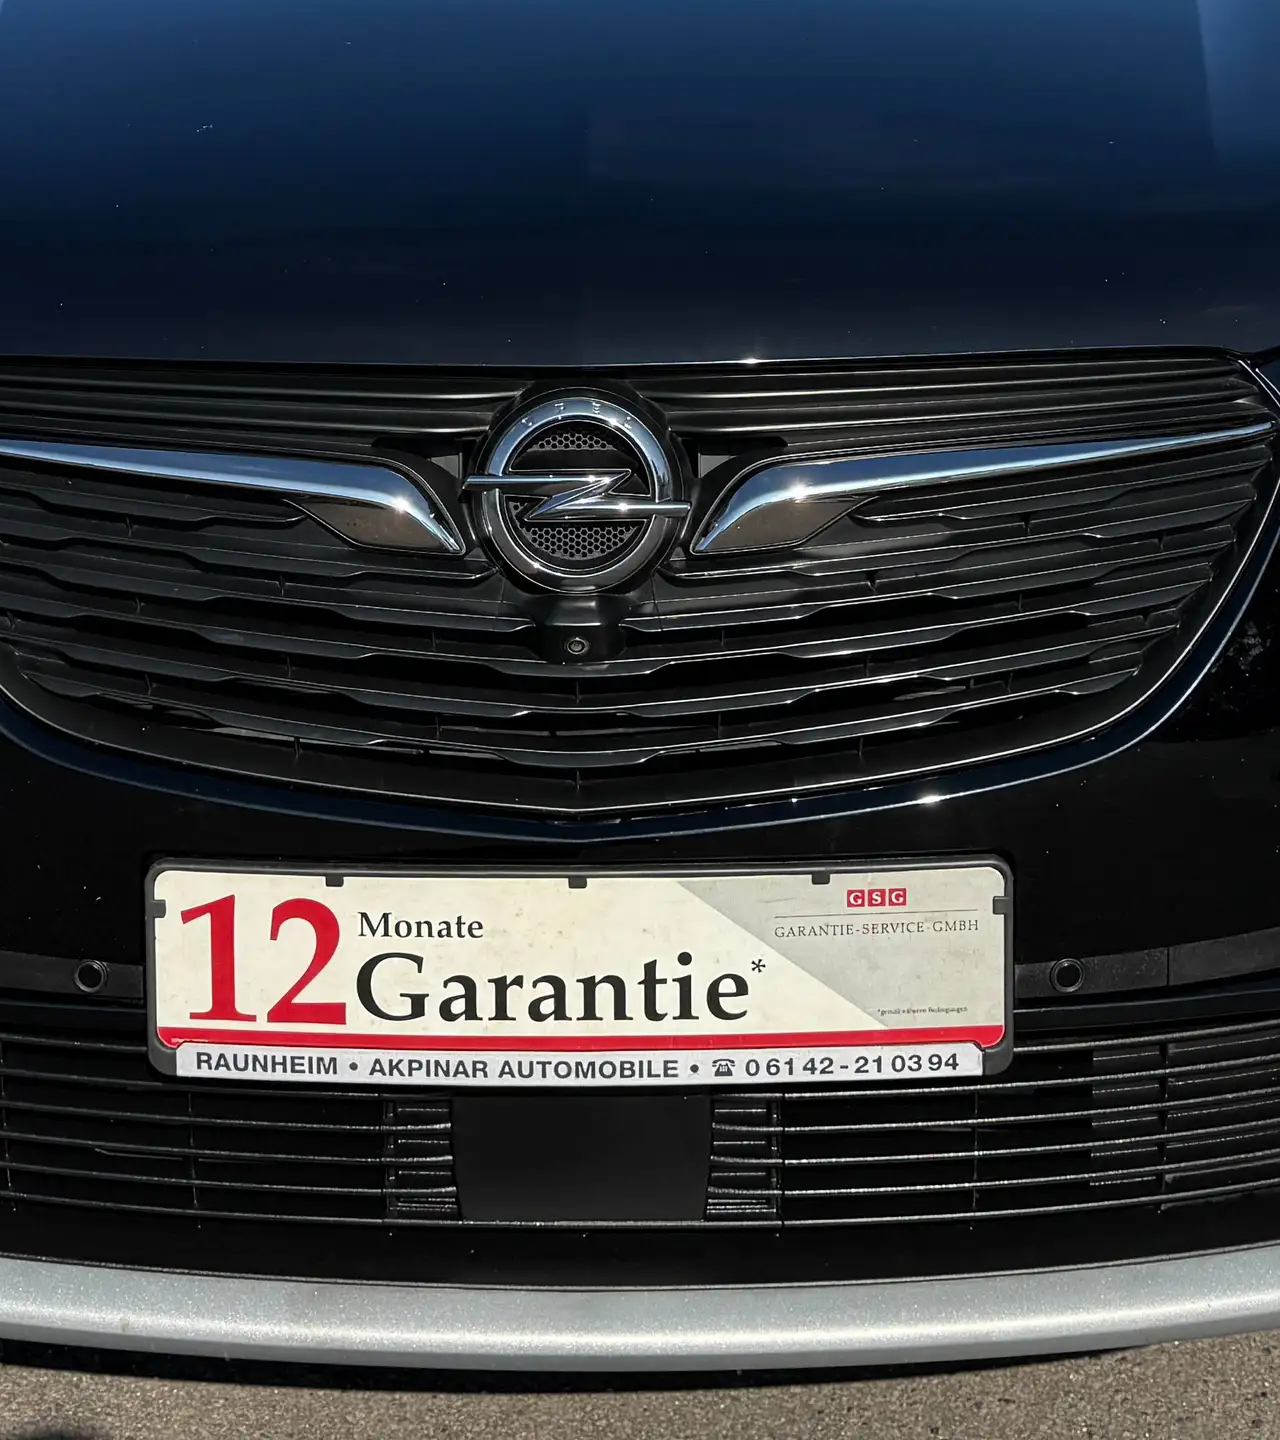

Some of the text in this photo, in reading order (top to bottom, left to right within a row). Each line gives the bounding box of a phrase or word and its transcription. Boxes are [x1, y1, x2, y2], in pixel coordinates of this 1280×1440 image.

[848, 889, 905, 906] GSG
[181, 894, 484, 1025] 12 Monate
[196, 1052, 338, 1075] RAUNHEIM
[369, 1058, 488, 1079] AKPINAR
[498, 1060, 679, 1081] AUTOMOBILE
